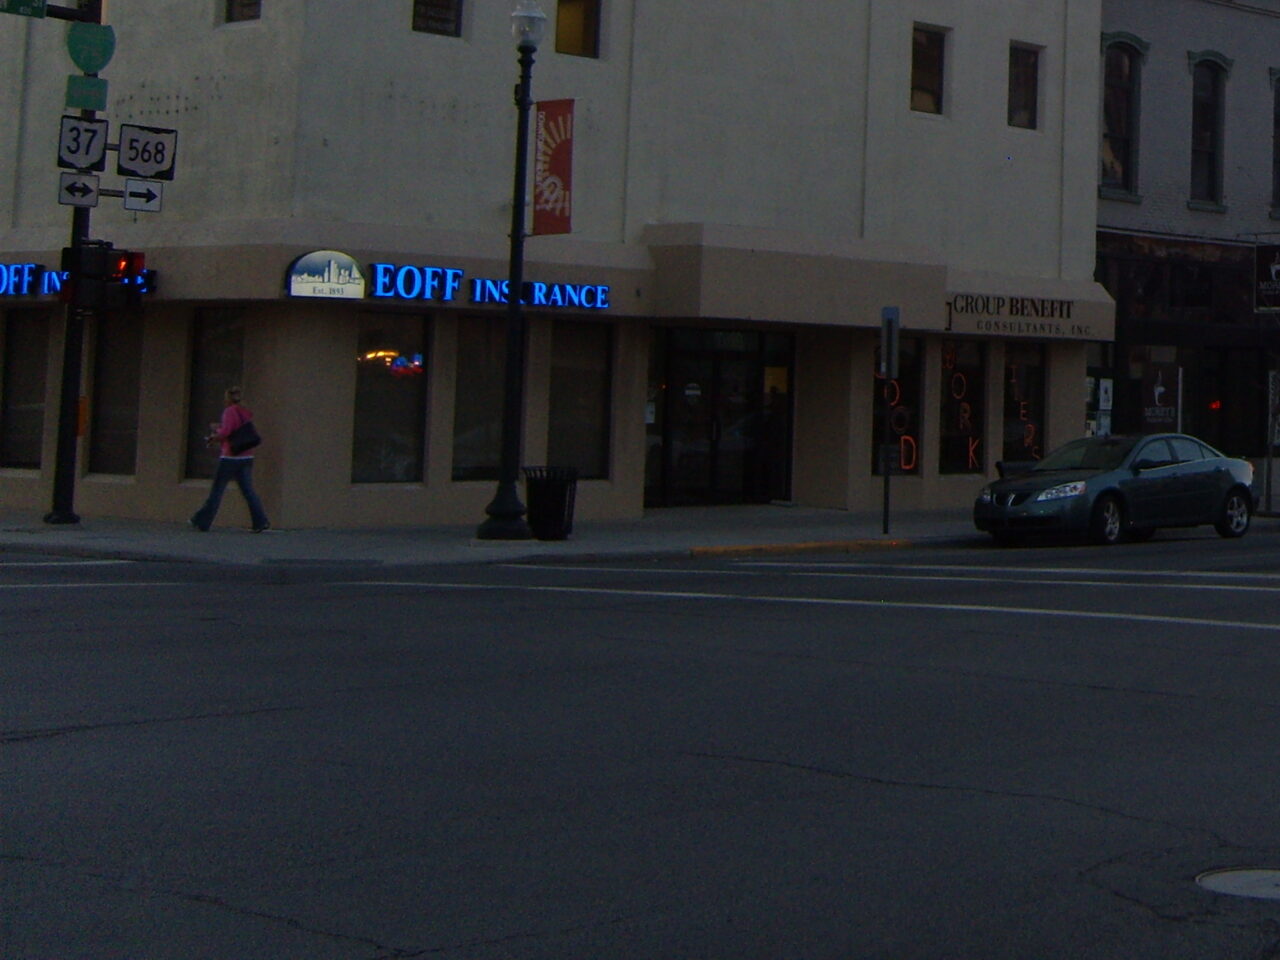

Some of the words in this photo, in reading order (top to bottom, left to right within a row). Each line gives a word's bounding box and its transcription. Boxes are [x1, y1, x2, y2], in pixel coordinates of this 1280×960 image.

[66, 126, 98, 155] 37
[128, 138, 167, 164] 568
[373, 262, 464, 301] EOFF
[472, 279, 609, 308] INSRANCE
[953, 295, 1005, 315] GROUP
[1009, 297, 1073, 319] BENEFIT
